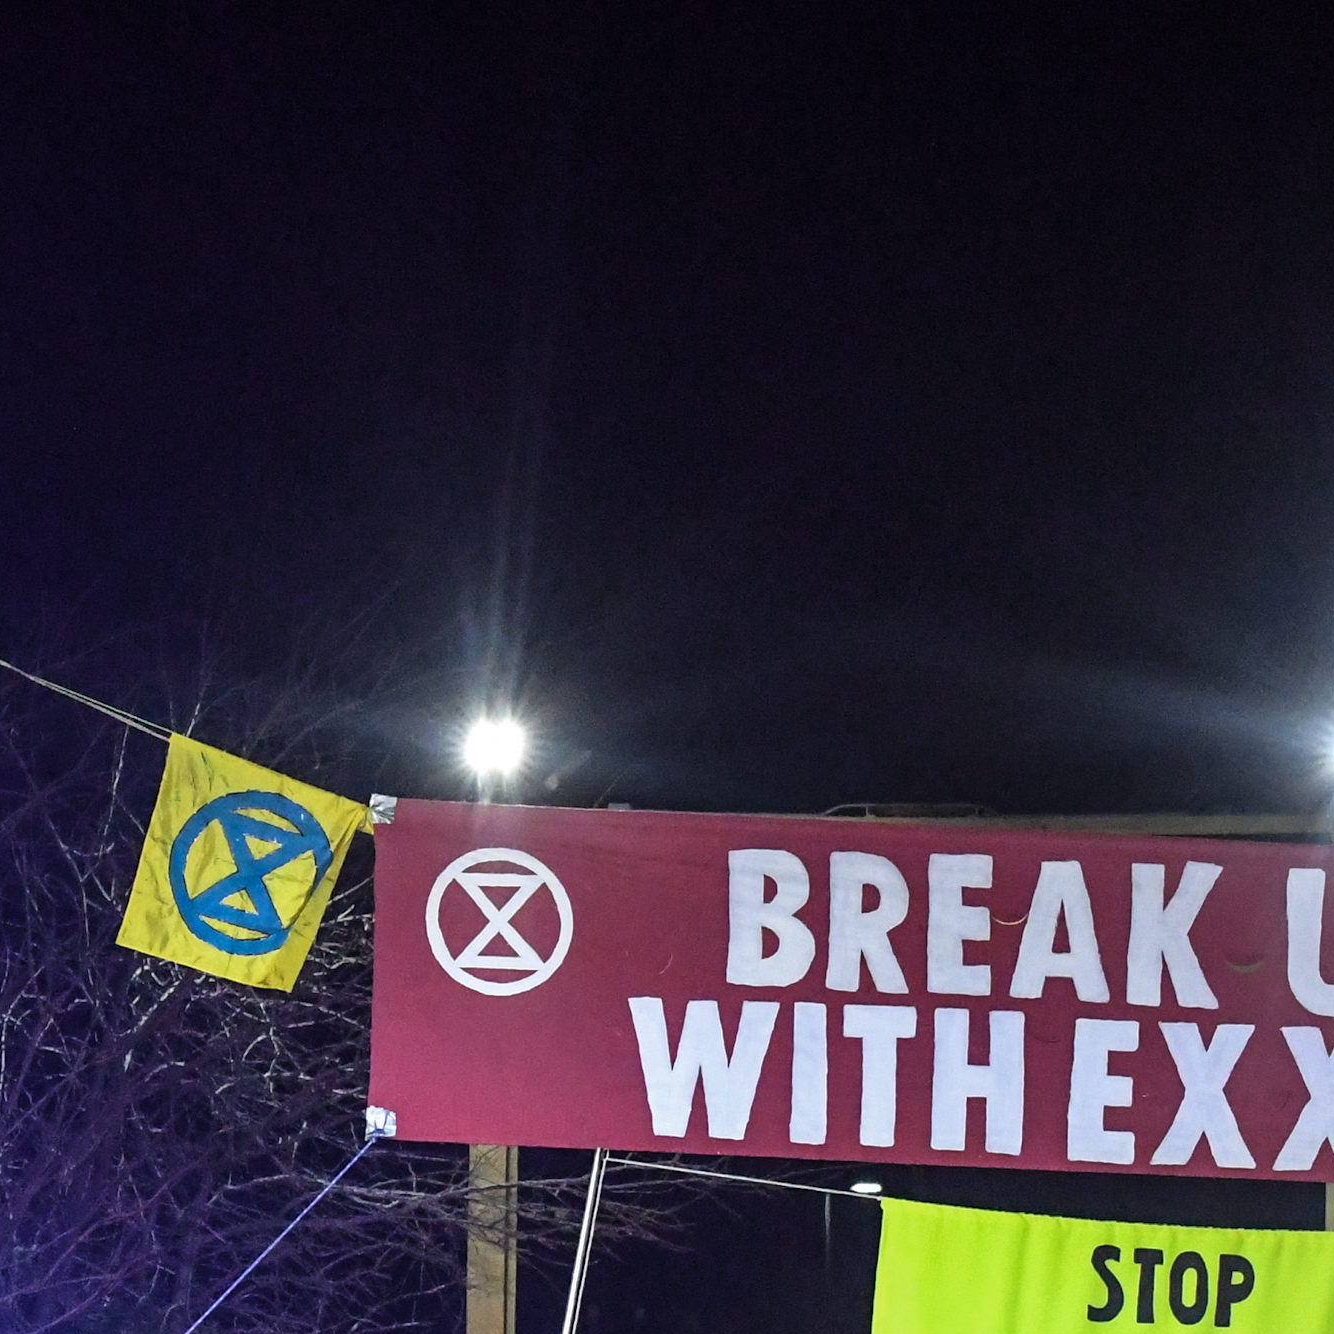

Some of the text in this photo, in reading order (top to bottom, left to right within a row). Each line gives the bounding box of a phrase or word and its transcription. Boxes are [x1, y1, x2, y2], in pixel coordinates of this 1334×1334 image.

[725, 848, 1224, 1010] BREAK
[627, 995, 1026, 1157] WITH
[1087, 1243, 1255, 1328] STOP
